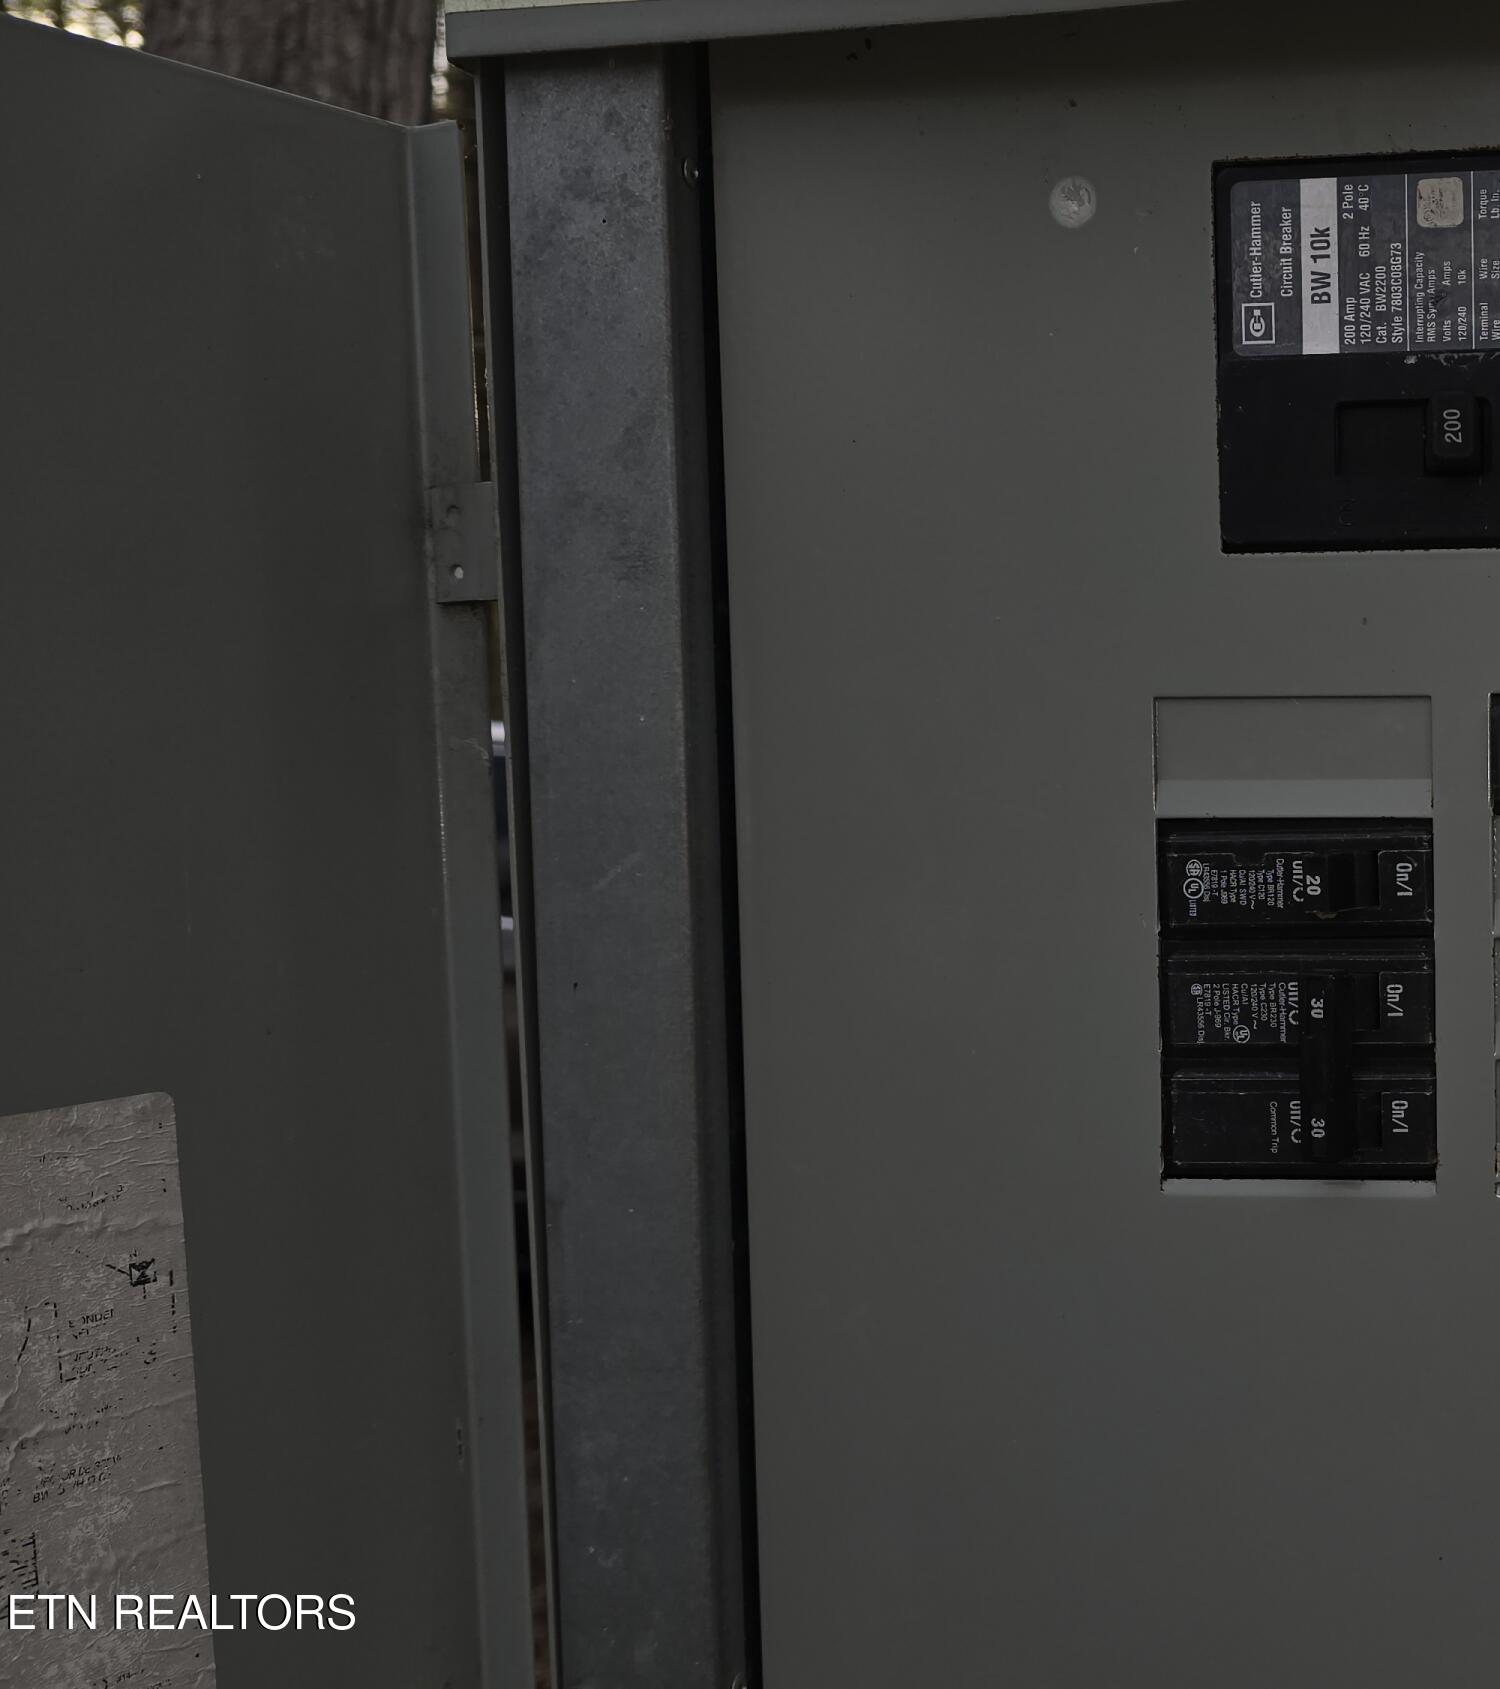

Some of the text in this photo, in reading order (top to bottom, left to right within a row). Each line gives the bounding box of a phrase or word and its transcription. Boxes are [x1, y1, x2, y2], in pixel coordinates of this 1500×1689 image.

[1342, 184, 1354, 208] Pole
[1479, 189, 1489, 218] Torque
[1249, 201, 1262, 298] Cutler-Hammer
[1280, 207, 1293, 296] Circuit Breaker
[1359, 226, 1370, 257] 60 Hz
[1310, 227, 1331, 304] BW 10k
[1443, 261, 1452, 285] Amps
[1458, 269, 1467, 285] 10k
[1480, 258, 1488, 279] Wire
[1491, 261, 1500, 279] Size
[1391, 243, 1405, 343] Style 7803C08G73
[1426, 269, 1436, 293] Amps
[1359, 273, 1372, 344] 120/240 VAC
[1375, 266, 1387, 343] Cat. BW2200
[1415, 252, 1425, 342] Interrupting Capacity
[1344, 297, 1357, 344] 200 Amp
[1427, 322, 1436, 342] RMS
[1443, 320, 1452, 342] Volts
[1458, 306, 1467, 341] 120/240
[1480, 303, 1489, 340] Terminal
[1492, 320, 1500, 340] Wire
[1444, 408, 1463, 445] 200
[1257, 869, 1265, 882] Type
[1266, 869, 1274, 882] Type
[1306, 875, 1321, 895] 20
[1229, 889, 1237, 903] Type
[1239, 889, 1247, 905] SWD
[1222, 984, 1230, 1010] LISTED
[1268, 982, 1276, 1000] Type
[1232, 1007, 1240, 1025] Type
[1279, 983, 1287, 1043] Cutler-Hammer
[1310, 998, 1323, 1018] 30
[1269, 1101, 1280, 1153] Common Trip
[1310, 1118, 1325, 1138] 30
